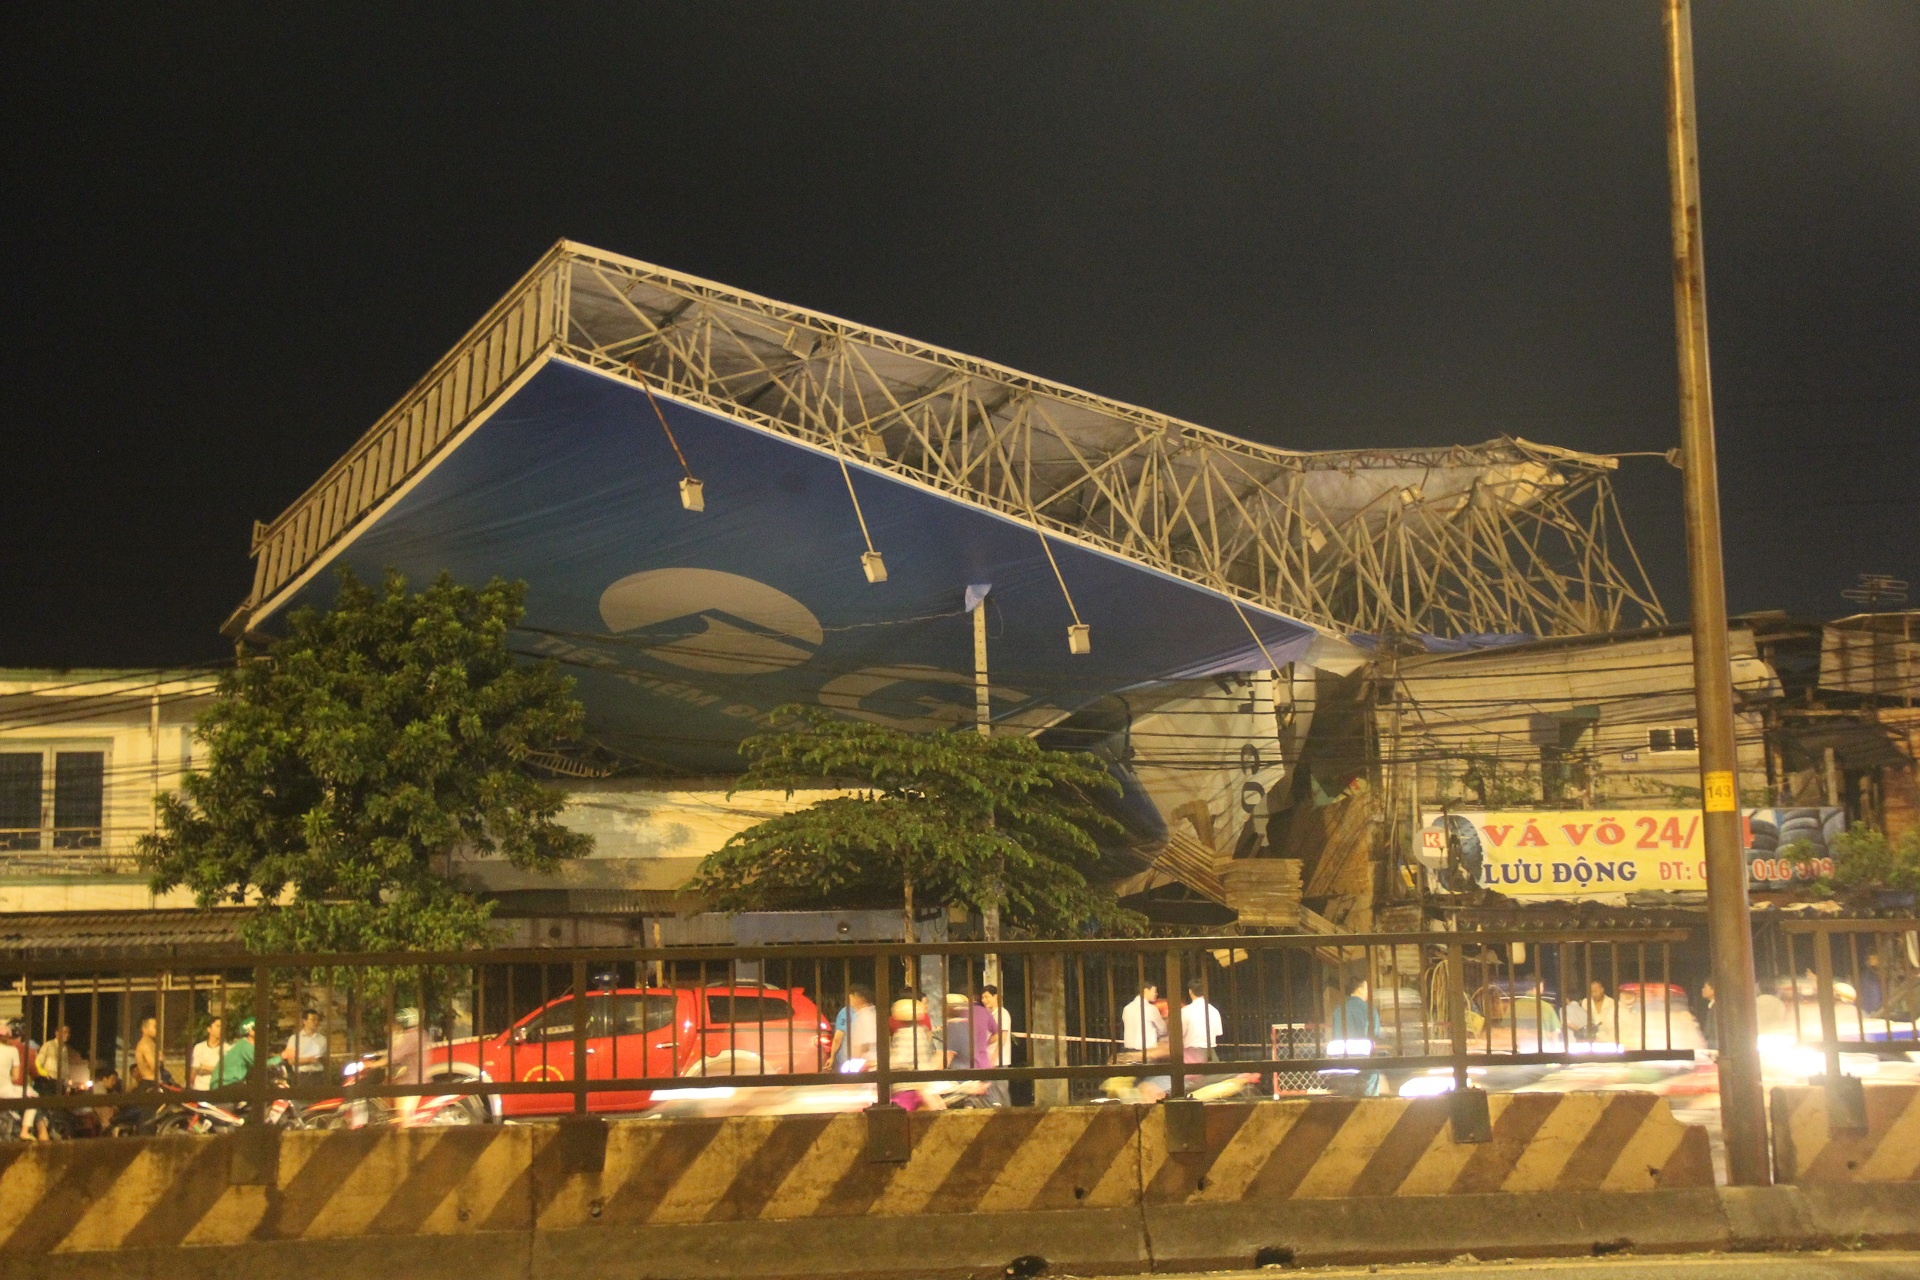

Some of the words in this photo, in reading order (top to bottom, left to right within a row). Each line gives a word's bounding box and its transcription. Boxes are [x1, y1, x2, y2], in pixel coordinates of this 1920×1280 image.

[1707, 785, 1732, 799] 143
[1480, 815, 1549, 848] VÁ
[1561, 815, 1626, 847] VÕ
[1483, 858, 1542, 884] LƯU
[1552, 856, 1638, 888] ĐỘNG
[1659, 861, 1691, 881] ĐT:
[1752, 858, 1792, 881] 016
